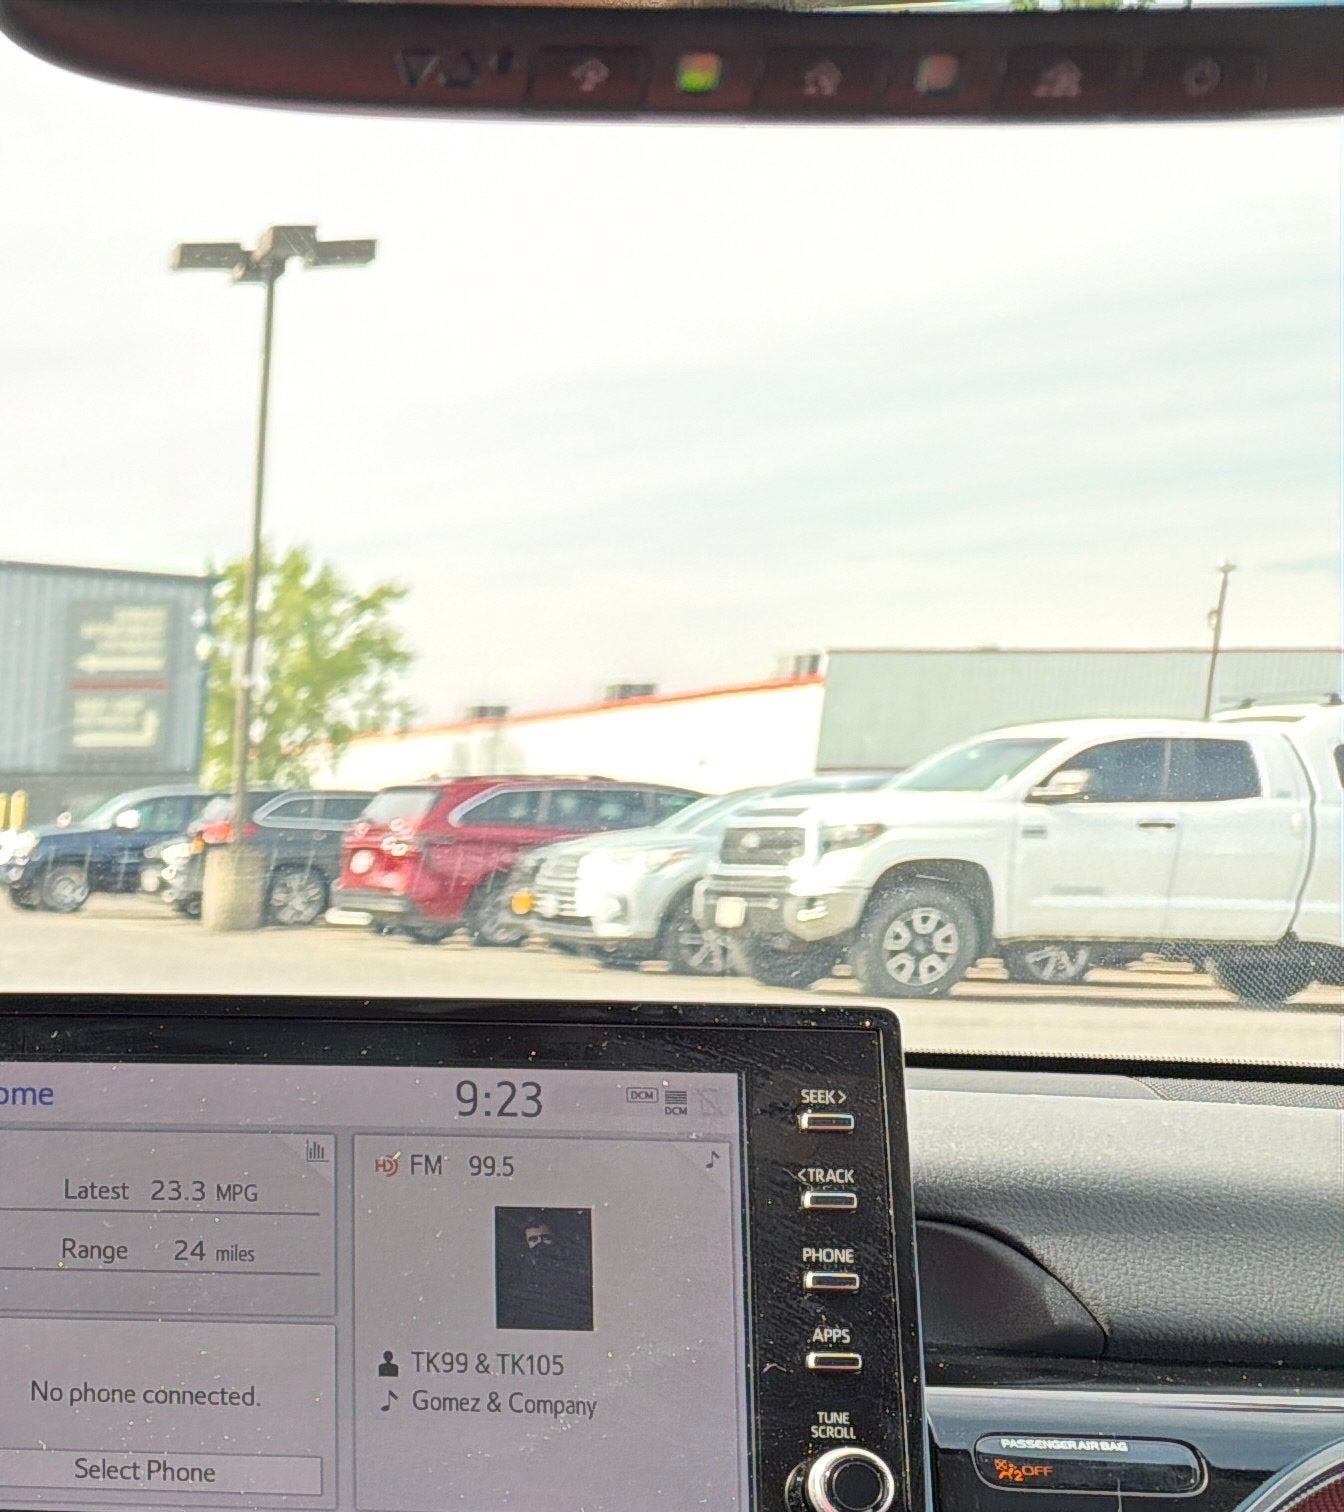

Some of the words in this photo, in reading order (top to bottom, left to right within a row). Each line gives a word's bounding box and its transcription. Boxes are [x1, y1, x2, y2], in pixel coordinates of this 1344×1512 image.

[456, 1079, 543, 1118] 9:23
[630, 1090, 654, 1100] DCM
[664, 1106, 688, 1115] DCM
[410, 1153, 443, 1176] FM
[468, 1155, 515, 1177] 99.5
[64, 1178, 130, 1201] Latest
[150, 1179, 206, 1202] 23.3
[215, 1183, 259, 1203] MPG
[61, 1237, 129, 1264] Range
[173, 1239, 207, 1262] 24
[215, 1243, 256, 1263] miles
[802, 1247, 855, 1263] PHONE
[812, 1327, 851, 1344] APPS
[411, 1350, 469, 1375] TK99
[474, 1353, 491, 1375] &
[496, 1353, 565, 1376] TK105
[30, 1379, 64, 1403] No
[69, 1381, 136, 1407] phone
[142, 1385, 261, 1408] connected.
[412, 1389, 481, 1414] Gomez
[486, 1391, 502, 1414] &
[508, 1391, 598, 1419] Company
[816, 1411, 850, 1424] TUNE
[810, 1425, 857, 1439] SCROLL
[1000, 1438, 1077, 1450] PASSENGER
[74, 1457, 141, 1481] Select
[147, 1459, 216, 1483] Phone
[1021, 1465, 1053, 1477] OFF
